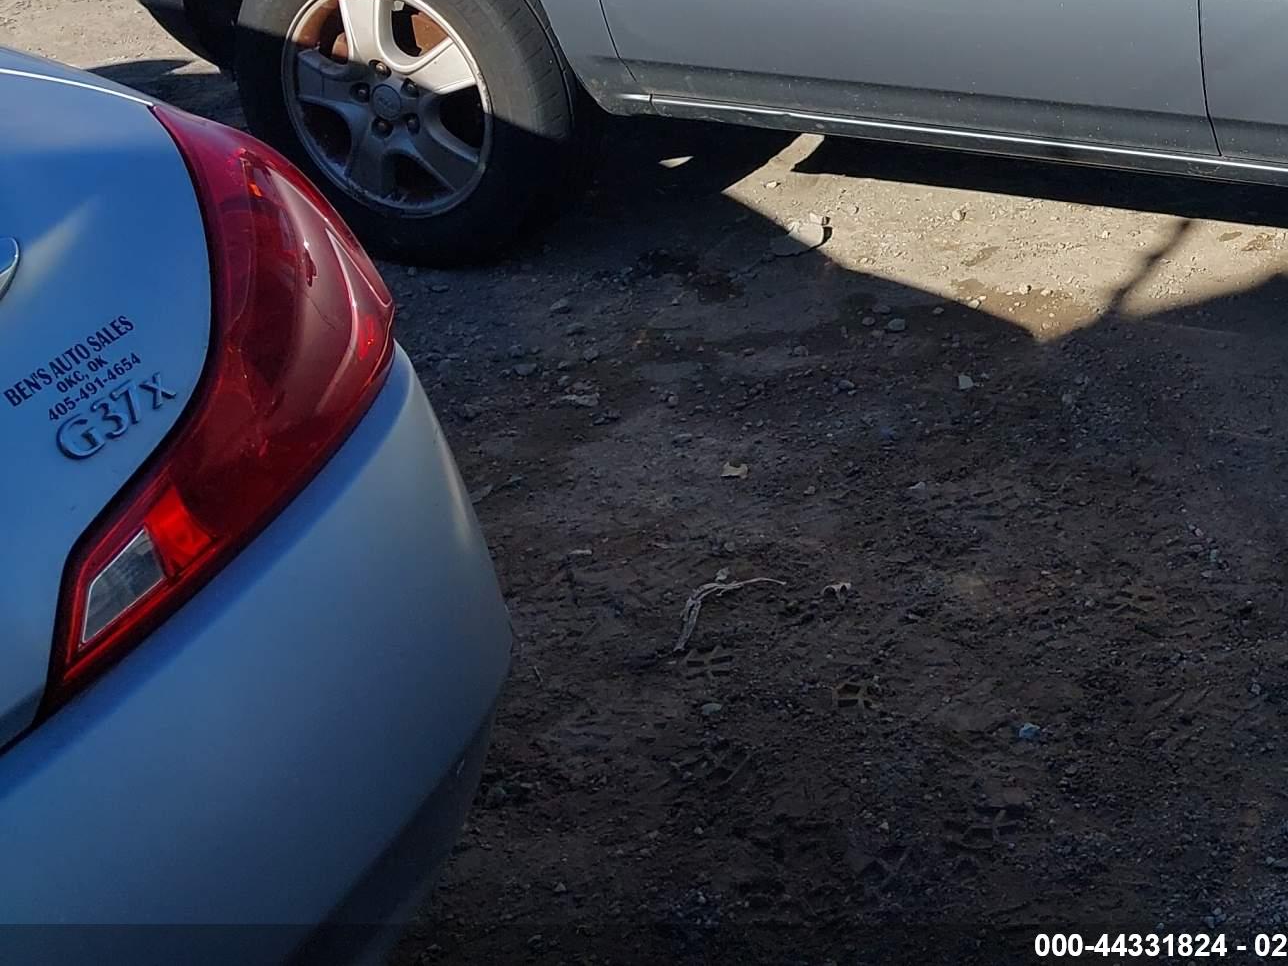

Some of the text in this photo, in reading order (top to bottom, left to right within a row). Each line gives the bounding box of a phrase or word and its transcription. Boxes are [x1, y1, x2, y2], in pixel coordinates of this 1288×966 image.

[3, 315, 134, 407] BEN'S AUTO SALES
[48, 352, 141, 421] 405-491-4654
[56, 354, 108, 393] OKC, OK
